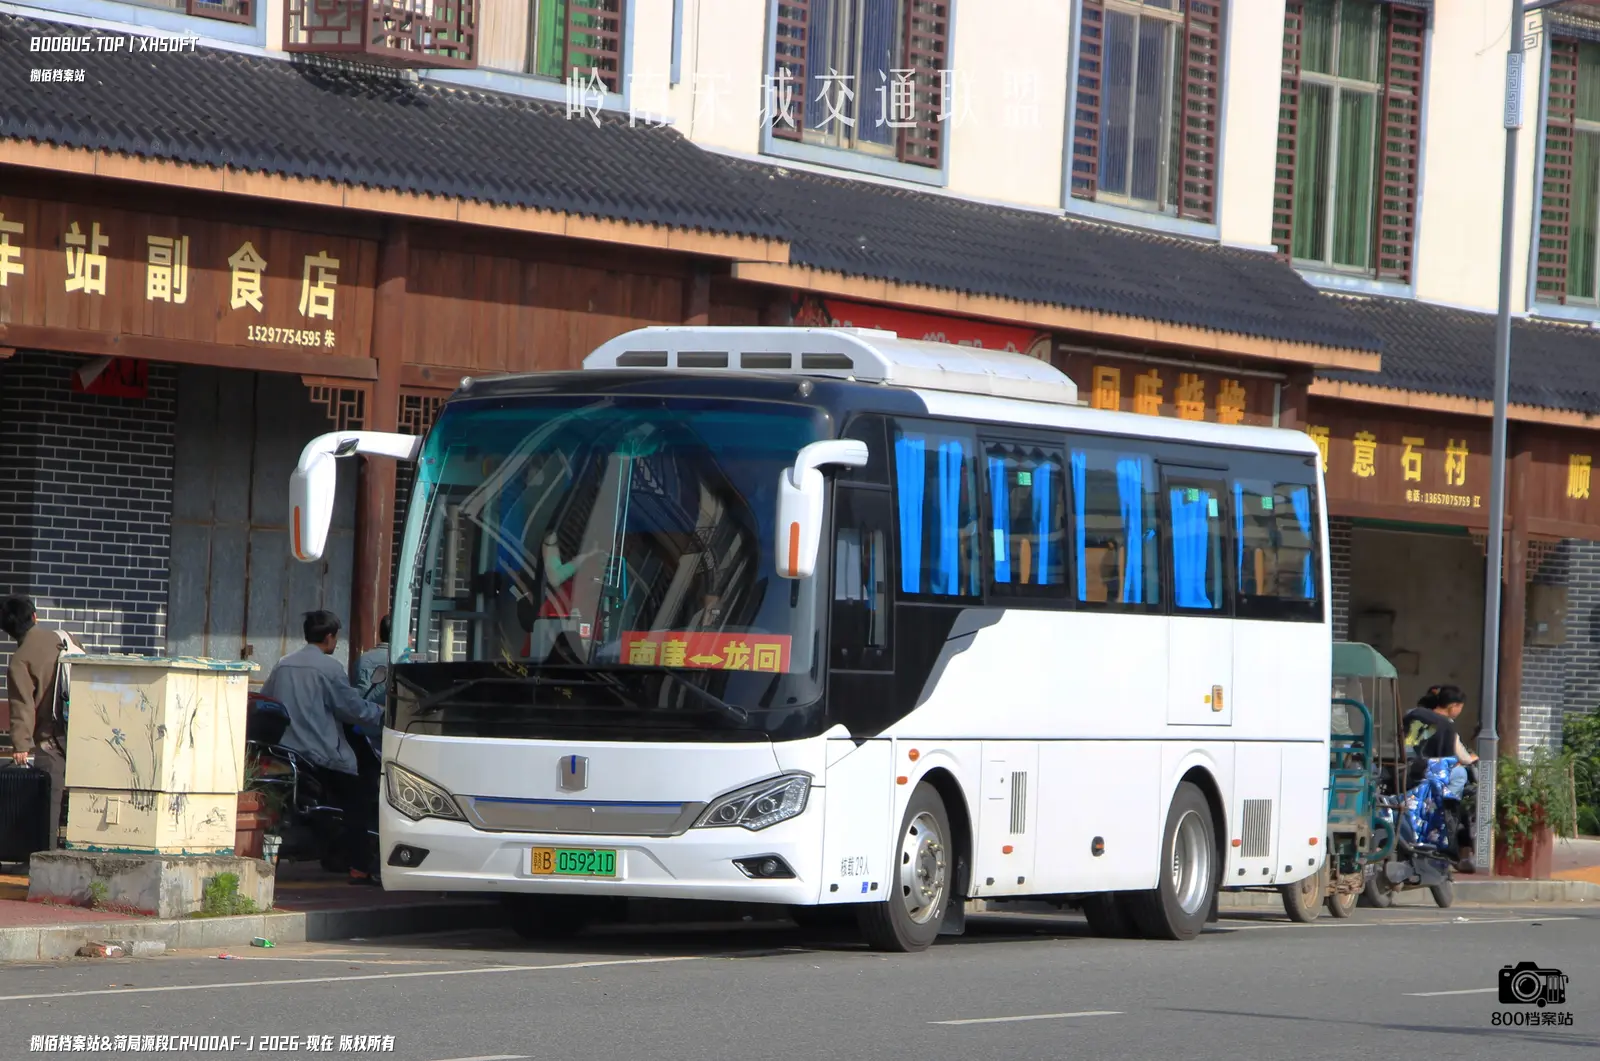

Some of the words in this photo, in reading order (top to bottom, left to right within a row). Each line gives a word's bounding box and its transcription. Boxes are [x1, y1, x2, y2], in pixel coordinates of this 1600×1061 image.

[0, 212, 340, 321] 车站副食店
[247, 325, 321, 347] 15297754595
[323, 329, 336, 348] 朱
